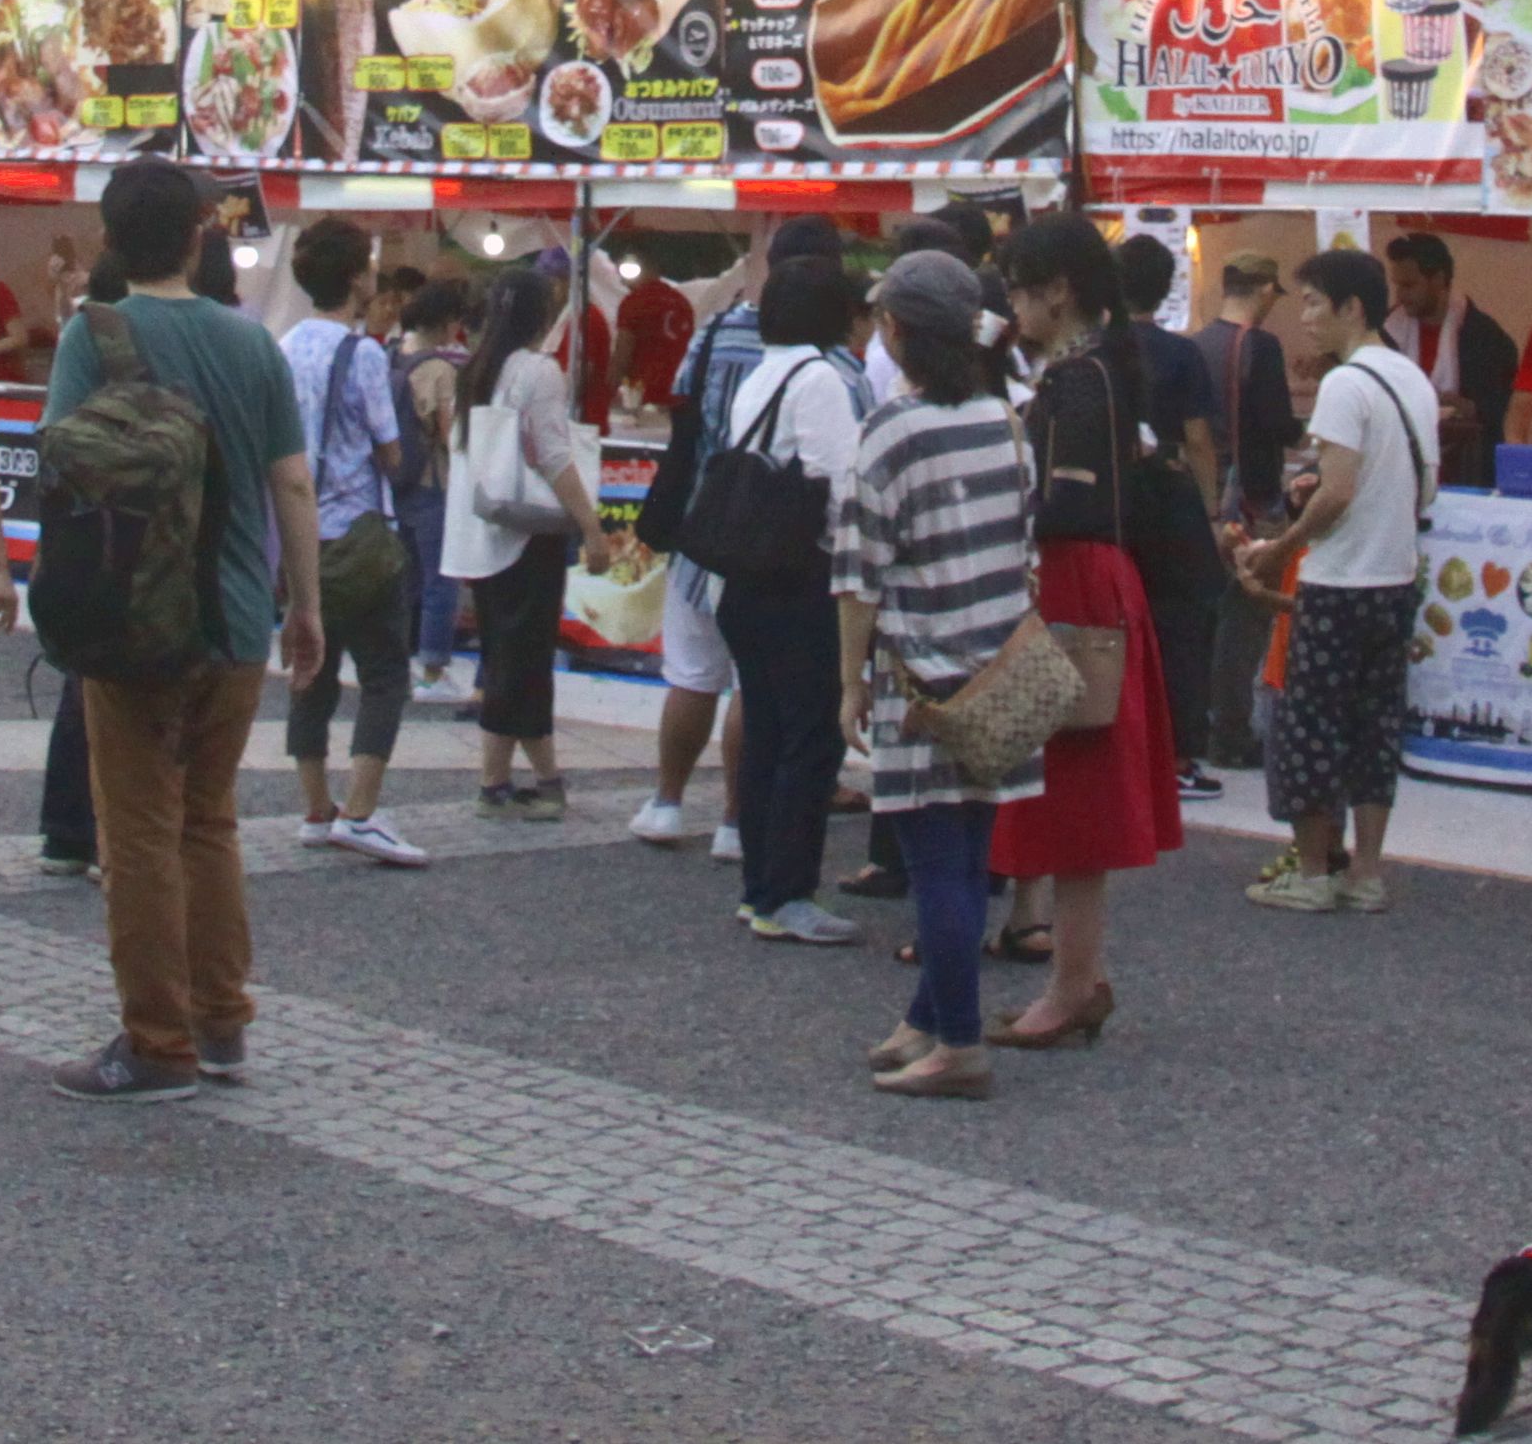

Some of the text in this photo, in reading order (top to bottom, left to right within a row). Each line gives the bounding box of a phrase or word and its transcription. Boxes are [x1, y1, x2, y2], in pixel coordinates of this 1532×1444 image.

[1116, 35, 1345, 89] HALAL TOKYO
[1111, 126, 1319, 158] https://halaltokyo.jp/
[601, 459, 658, 485] ecial
